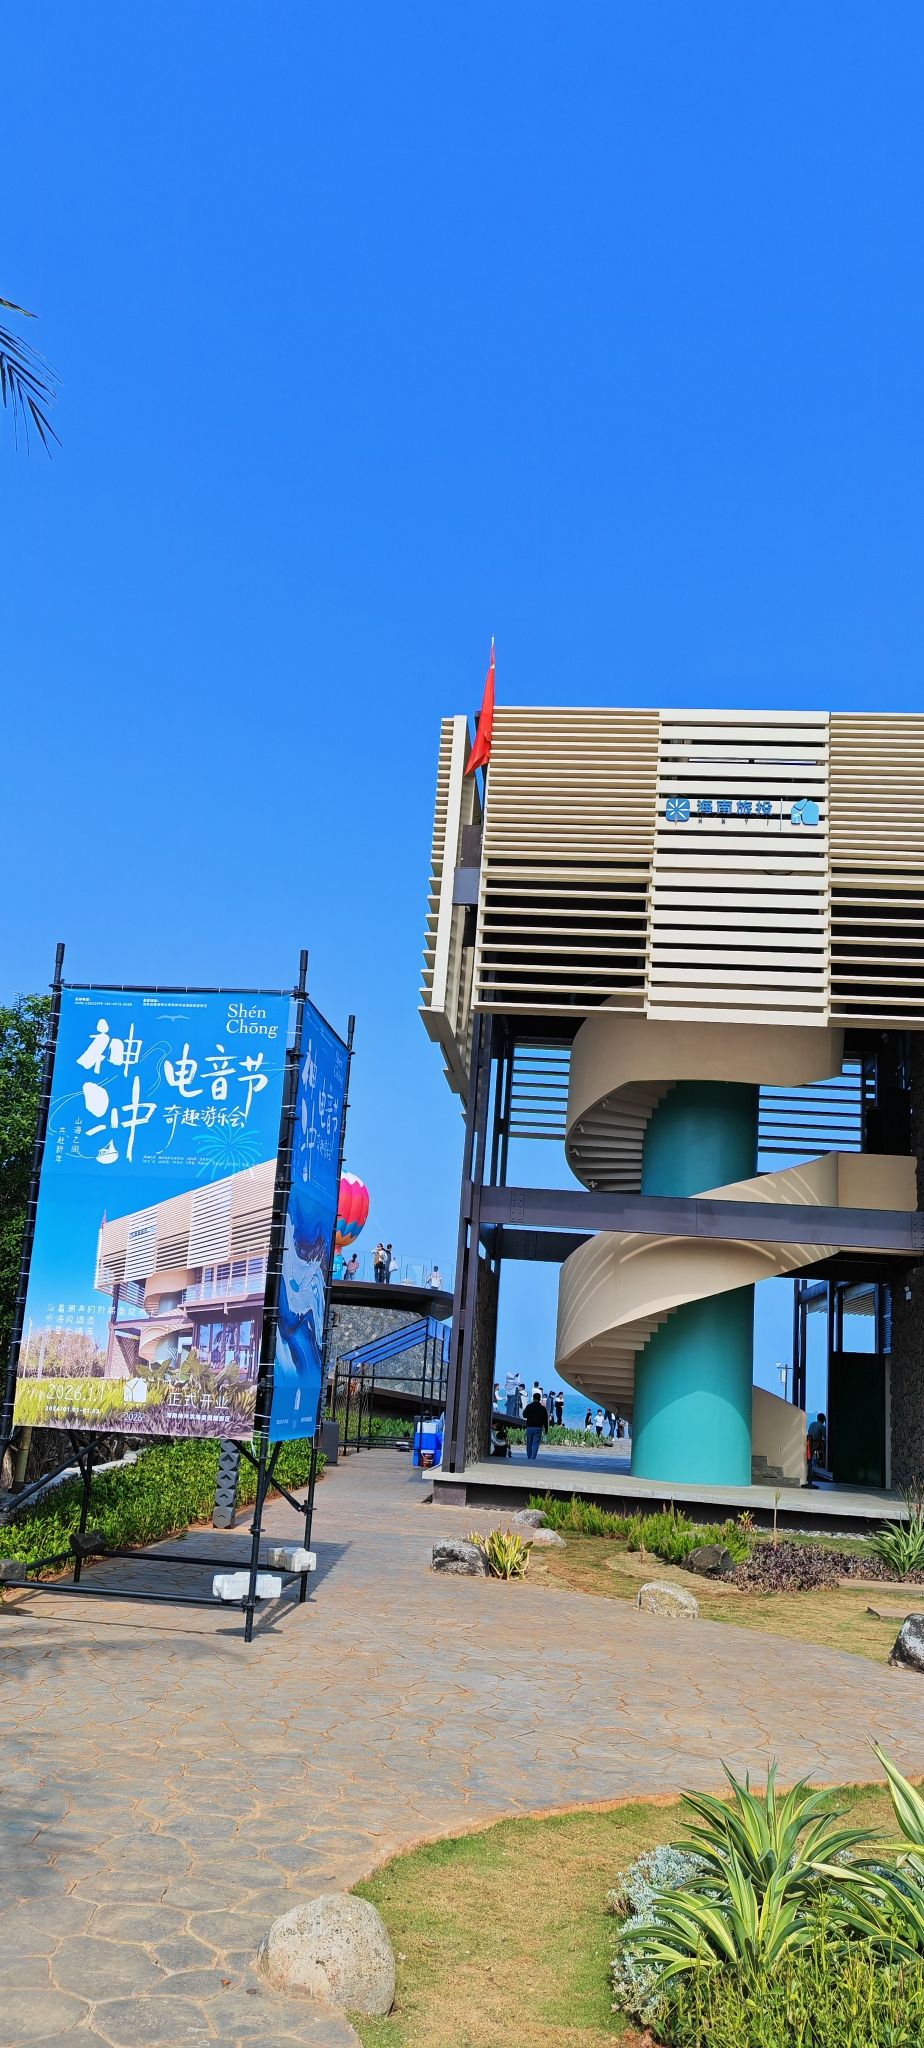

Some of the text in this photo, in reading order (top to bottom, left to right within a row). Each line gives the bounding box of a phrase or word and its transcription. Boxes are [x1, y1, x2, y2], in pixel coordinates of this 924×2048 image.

[696, 799, 772, 815] 海南旅投
[228, 1003, 266, 1018] Shén
[226, 1019, 278, 1039] Chōng
[76, 1019, 157, 1164] 神冲
[164, 1043, 268, 1123] 电音节
[318, 1076, 338, 1152] 电音节
[46, 1383, 104, 1402] 2026.1.1
[167, 1391, 230, 1410] 正式开业
[124, 1412, 143, 1422] 2026
